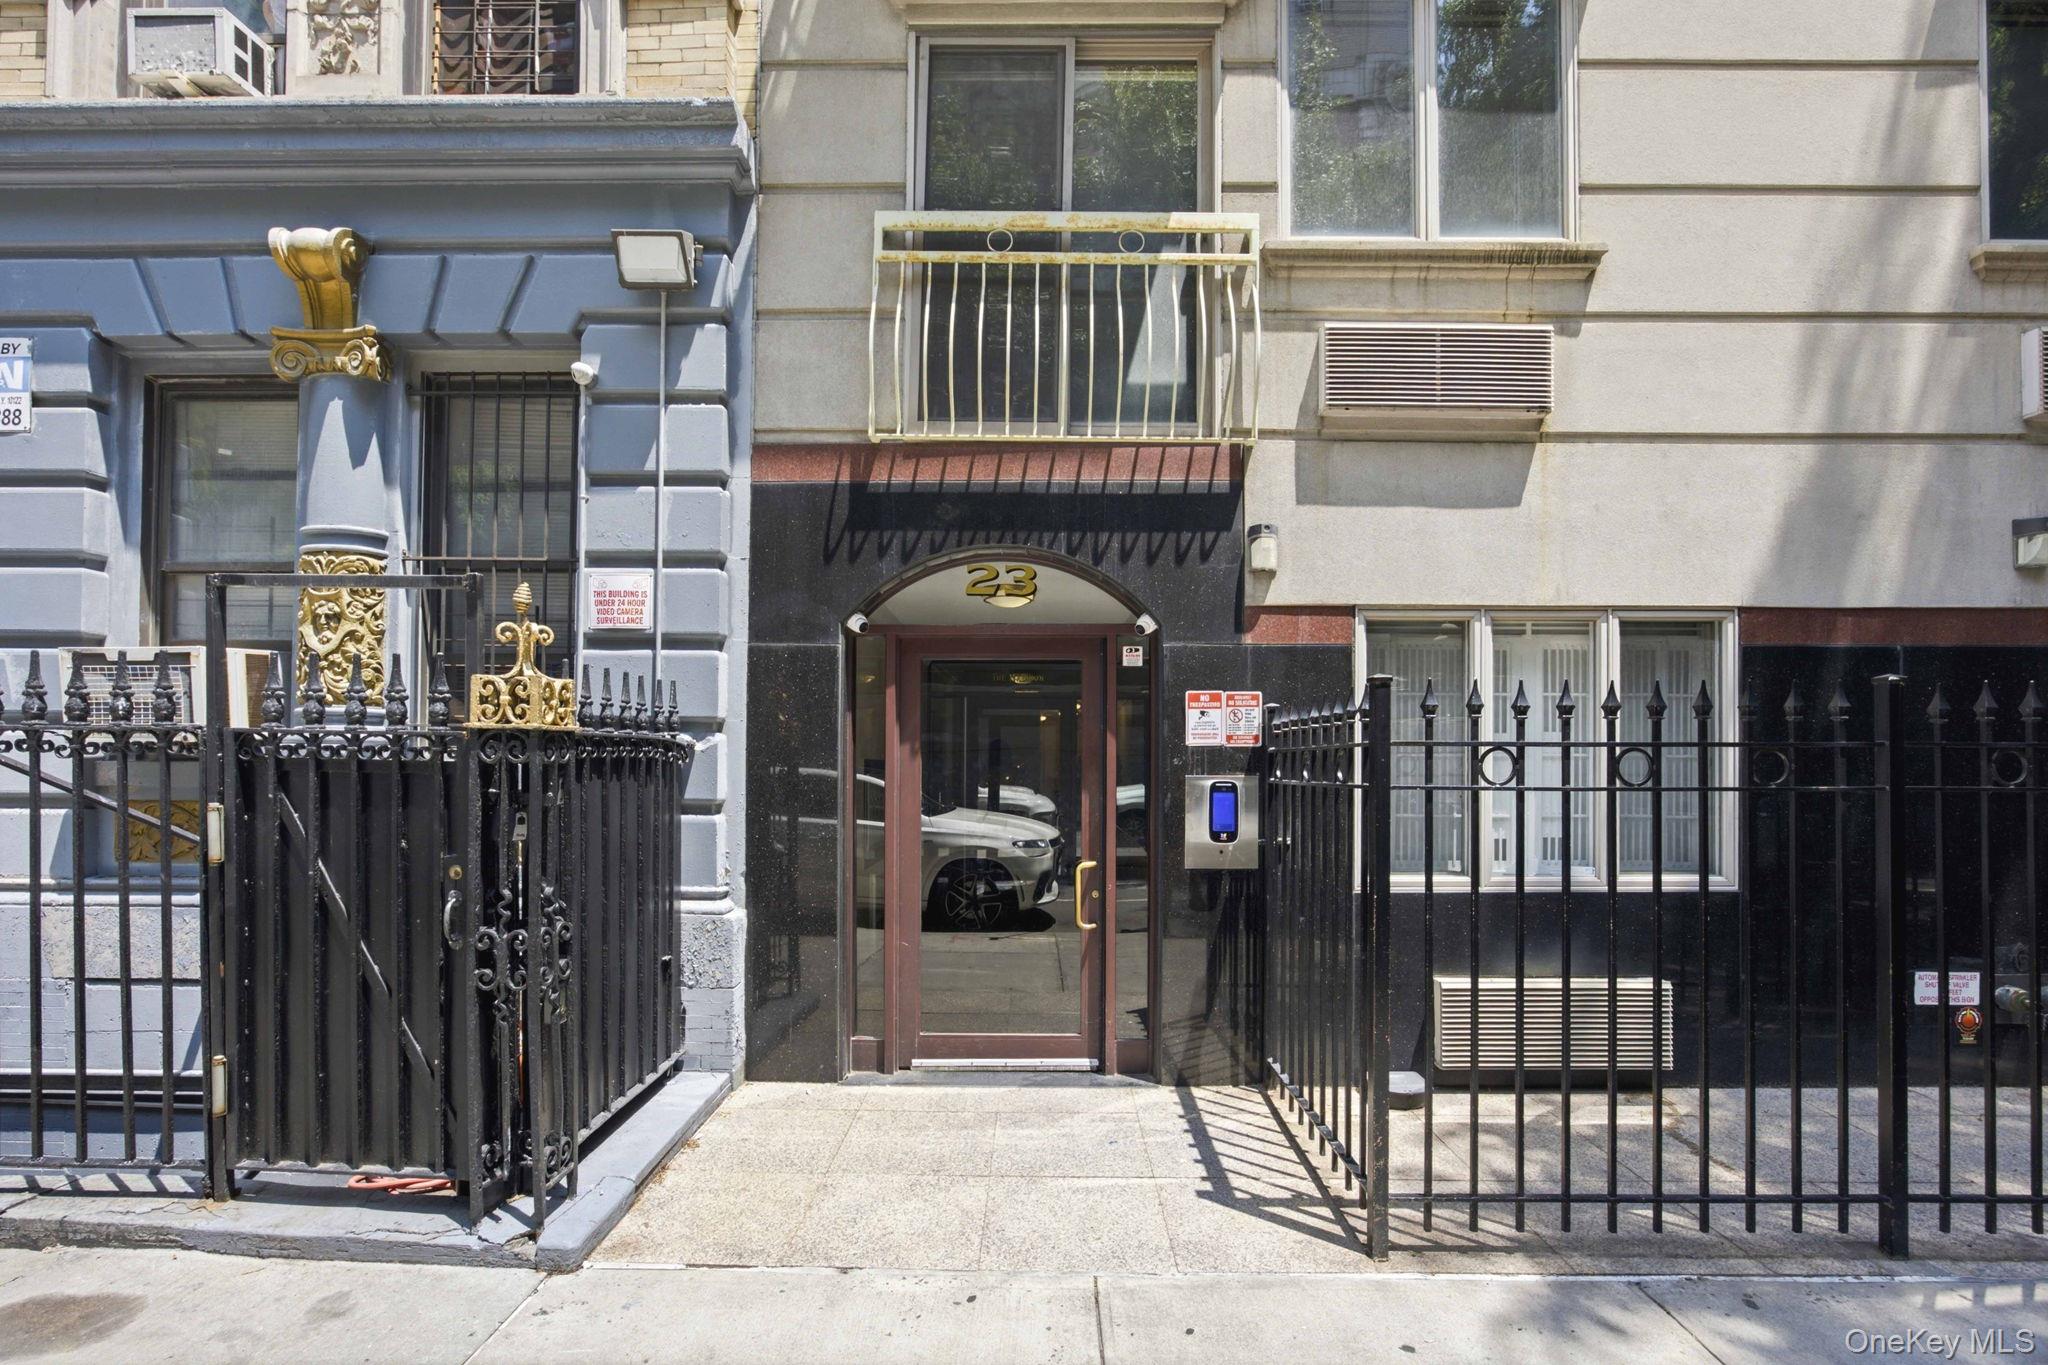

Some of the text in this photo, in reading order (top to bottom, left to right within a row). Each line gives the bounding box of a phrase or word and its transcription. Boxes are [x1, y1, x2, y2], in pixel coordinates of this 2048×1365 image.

[1, 343, 21, 354] BY
[0, 409, 22, 426] 88
[966, 564, 1037, 597] 23
[593, 590, 648, 598] THIS BUILDING IS
[594, 599, 646, 607] UNDER 24 HOUR
[596, 608, 644, 616] VIDEO CAMERA
[596, 616, 644, 625] SURVEILLANCE
[1200, 694, 1210, 702] NO
